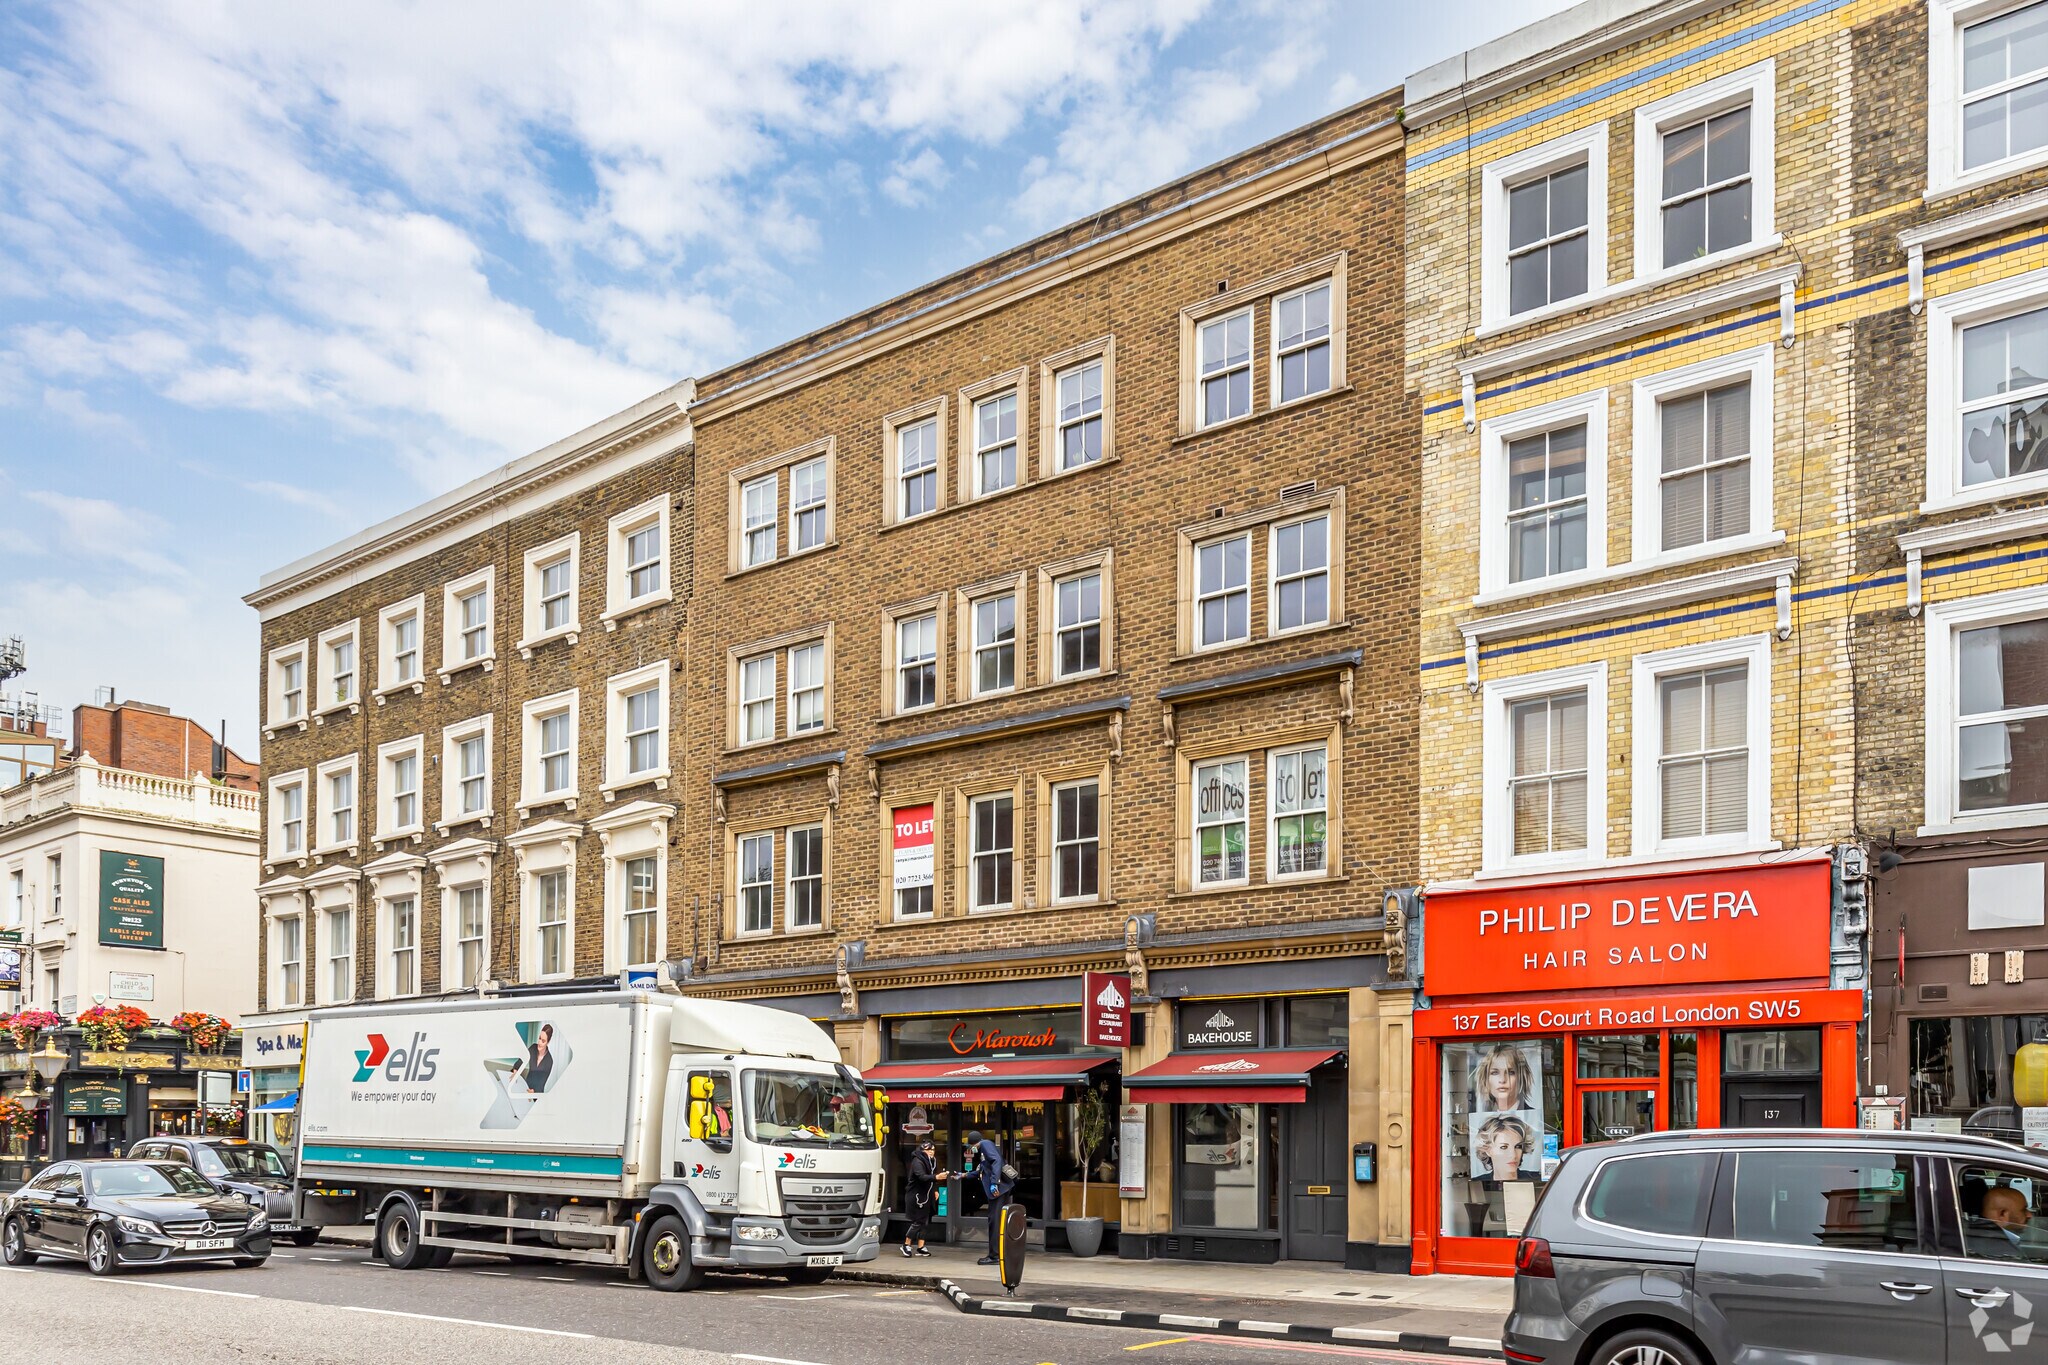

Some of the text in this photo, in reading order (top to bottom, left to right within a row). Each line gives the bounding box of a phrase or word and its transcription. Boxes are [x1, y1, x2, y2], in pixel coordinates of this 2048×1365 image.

[1278, 763, 1326, 804] to let
[1200, 777, 1245, 814] offices
[896, 819, 934, 837] TO LET
[111, 877, 144, 887] PURVEYOR
[133, 899, 150, 907] ALES
[1479, 903, 1591, 936] PHILIP
[109, 927, 130, 935] EARLS
[1523, 942, 1708, 970] HAIR SALON
[1452, 1000, 1801, 1030] 137 Earls Court Road London SW5
[1099, 1019, 1123, 1027] RESTAURANT
[948, 1022, 1056, 1054] Maroush
[1188, 1031, 1252, 1043] BAKEHOUSE
[257, 1036, 274, 1055] Spa
[276, 1035, 284, 1050] &
[385, 1032, 440, 1081] elis
[351, 1090, 436, 1104] We empower your day
[907, 1091, 966, 1099] www.maroush.com
[1764, 1110, 1780, 1119] 137
[794, 1153, 817, 1168] elis
[702, 1165, 721, 1179] elis
[811, 1186, 843, 1194] DAF
[208, 1239, 225, 1248] SFH
[811, 1256, 839, 1265] MX16 LJE
